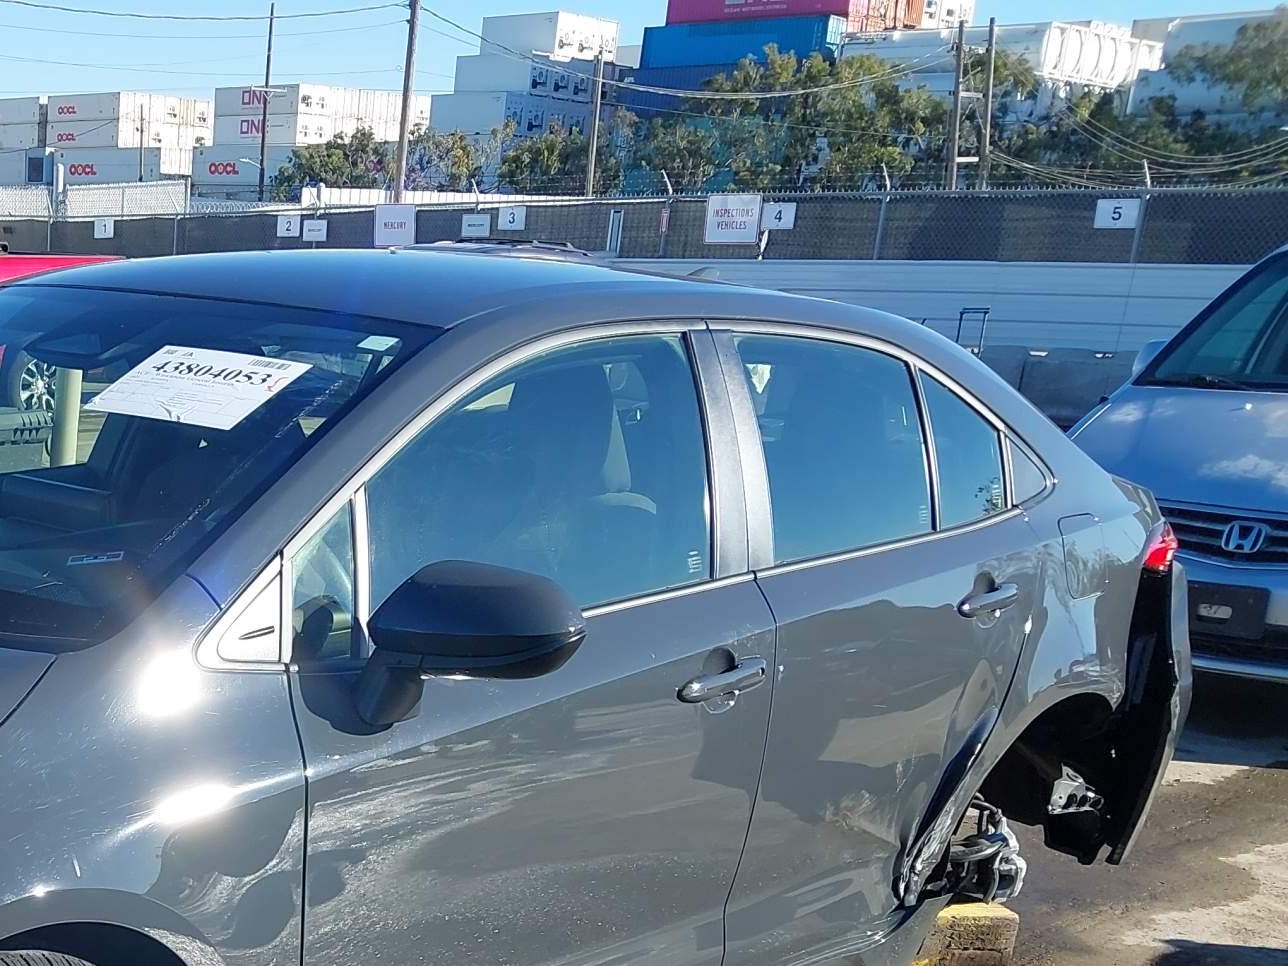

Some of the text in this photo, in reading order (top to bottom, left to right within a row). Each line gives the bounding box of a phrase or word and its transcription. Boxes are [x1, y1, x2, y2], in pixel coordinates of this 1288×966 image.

[58, 106, 77, 115] OOCL
[57, 133, 76, 142] OOCL
[69, 164, 97, 176] OOCL
[208, 162, 239, 175] OOCL
[508, 212, 516, 224] 3
[712, 208, 754, 218] INSPECTIONS
[774, 209, 783, 223] 4
[1111, 206, 1123, 221] 5
[285, 220, 292, 231] 2
[383, 221, 406, 230] MERCURY
[716, 220, 747, 230] VEHICLES
[151, 360, 272, 386] 43804053
